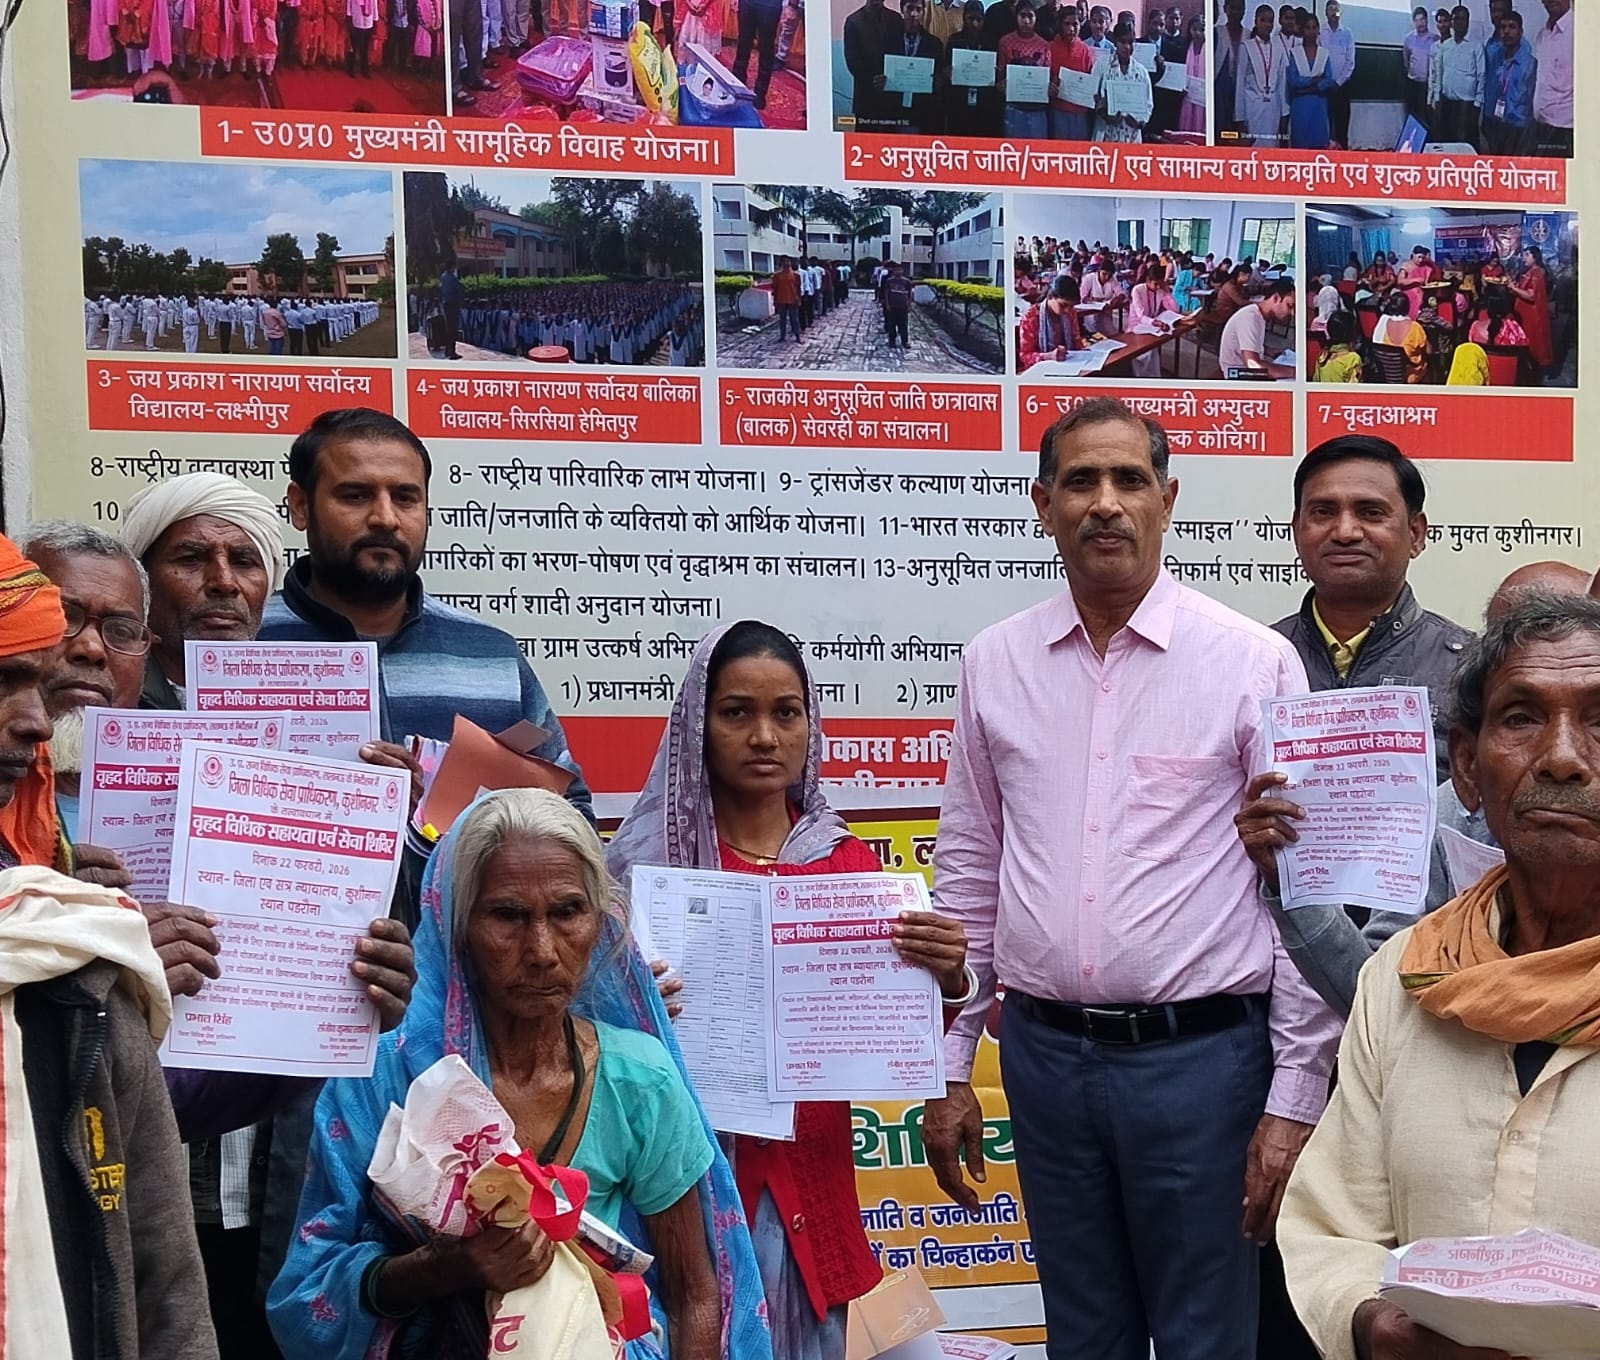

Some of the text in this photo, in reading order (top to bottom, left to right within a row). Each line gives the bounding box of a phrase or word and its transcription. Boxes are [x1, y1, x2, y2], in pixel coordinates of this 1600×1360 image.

[217, 120, 244, 143] 1-
[343, 118, 447, 159] मुख्यमंत्री
[453, 122, 552, 163] सामूहिक
[558, 125, 625, 161] विवाह
[631, 128, 720, 165] योजना।
[850, 141, 1557, 195] 2- अनुसूचित जाति/जनजाति/ एवं सामान्य वर्ग छात्रवृत्ति एवं शुल्क प्रतिपूर्ति योजना
[98, 368, 371, 394] 3- जय प्रकाश नारायण सर्वोदय
[416, 376, 697, 402] 4- जय प्रकाश नारायण सर्वोदय बालिका
[128, 396, 289, 428] विद्यालय-लक्ष्मीपुर
[725, 381, 998, 415] 5- राजकीय अनुसूचित जाति छात्रावास
[1026, 395, 1048, 414] 6-
[1121, 391, 1198, 418] मख्यमंत्री
[1202, 399, 1270, 425] अभ्युदय
[440, 404, 574, 431] विद्यालय-सिरसिया
[736, 412, 949, 444] (बालक) सेवरही का संचालन।
[1197, 424, 1267, 452] कोचिंग।
[91, 450, 182, 482] 8-राष्ट्रीय
[449, 458, 1031, 497] 8- राष्ट्रीय पारिवारिक लाभ योजना। 9- ट्रांसजेंडर कल्याण योजना
[440, 502, 578, 534] जाति/जनजाति
[585, 503, 603, 529] के
[608, 505, 687, 532] व्यक्तियो
[693, 506, 718, 532] को
[725, 507, 790, 534] आर्थिक
[796, 508, 865, 536] योजना।
[879, 515, 958, 538] 11-भारत
[963, 518, 1027, 538] सरकार
[1253, 515, 1294, 541] योज
[1449, 524, 1488, 552] मुक्त
[1495, 518, 1583, 553] कुशीनगर।
[500, 552, 526, 572] का
[532, 546, 640, 574] भरण-पोषण
[645, 548, 673, 576] एवं
[678, 555, 749, 582] वृद्धाश्रम
[754, 555, 780, 576] का
[785, 552, 866, 579] संचालन।
[873, 552, 991, 586] 13-अनुसूचित
[1163, 554, 1221, 582] निफार्म
[1226, 557, 1254, 584] एवं
[486, 586, 517, 614] वर्ग
[521, 587, 570, 615] शादी
[575, 595, 645, 623] अनुदान
[650, 590, 722, 619] योजना।
[541, 638, 579, 659] ग्राम
[583, 631, 642, 660] उत्कर्ष
[809, 634, 885, 661] कर्मयोगी
[891, 635, 963, 662] अभियान
[223, 690, 257, 706] विधिक
[258, 693, 297, 706] सहायता
[316, 691, 336, 706] सेवा
[337, 690, 367, 706] शिविर
[561, 674, 675, 709] 1) प्रधानमंत्री
[897, 677, 918, 711] 2)
[124, 767, 162, 786] विधिक
[229, 771, 250, 795] जिला
[252, 774, 278, 799] विधिक
[280, 778, 297, 801] सेवा
[341, 788, 380, 816] कुशीनगर
[193, 811, 395, 855] वृहद विधिक सहायता एवं सेवा शिविर
[233, 870, 256, 888] जिला
[280, 857, 291, 868] 22
[328, 864, 350, 875] 2026
[796, 923, 826, 939] विधिक
[908, 1207, 925, 1227] व
[928, 1193, 1018, 1226] जनजाति
[887, 1248, 916, 1269] का
